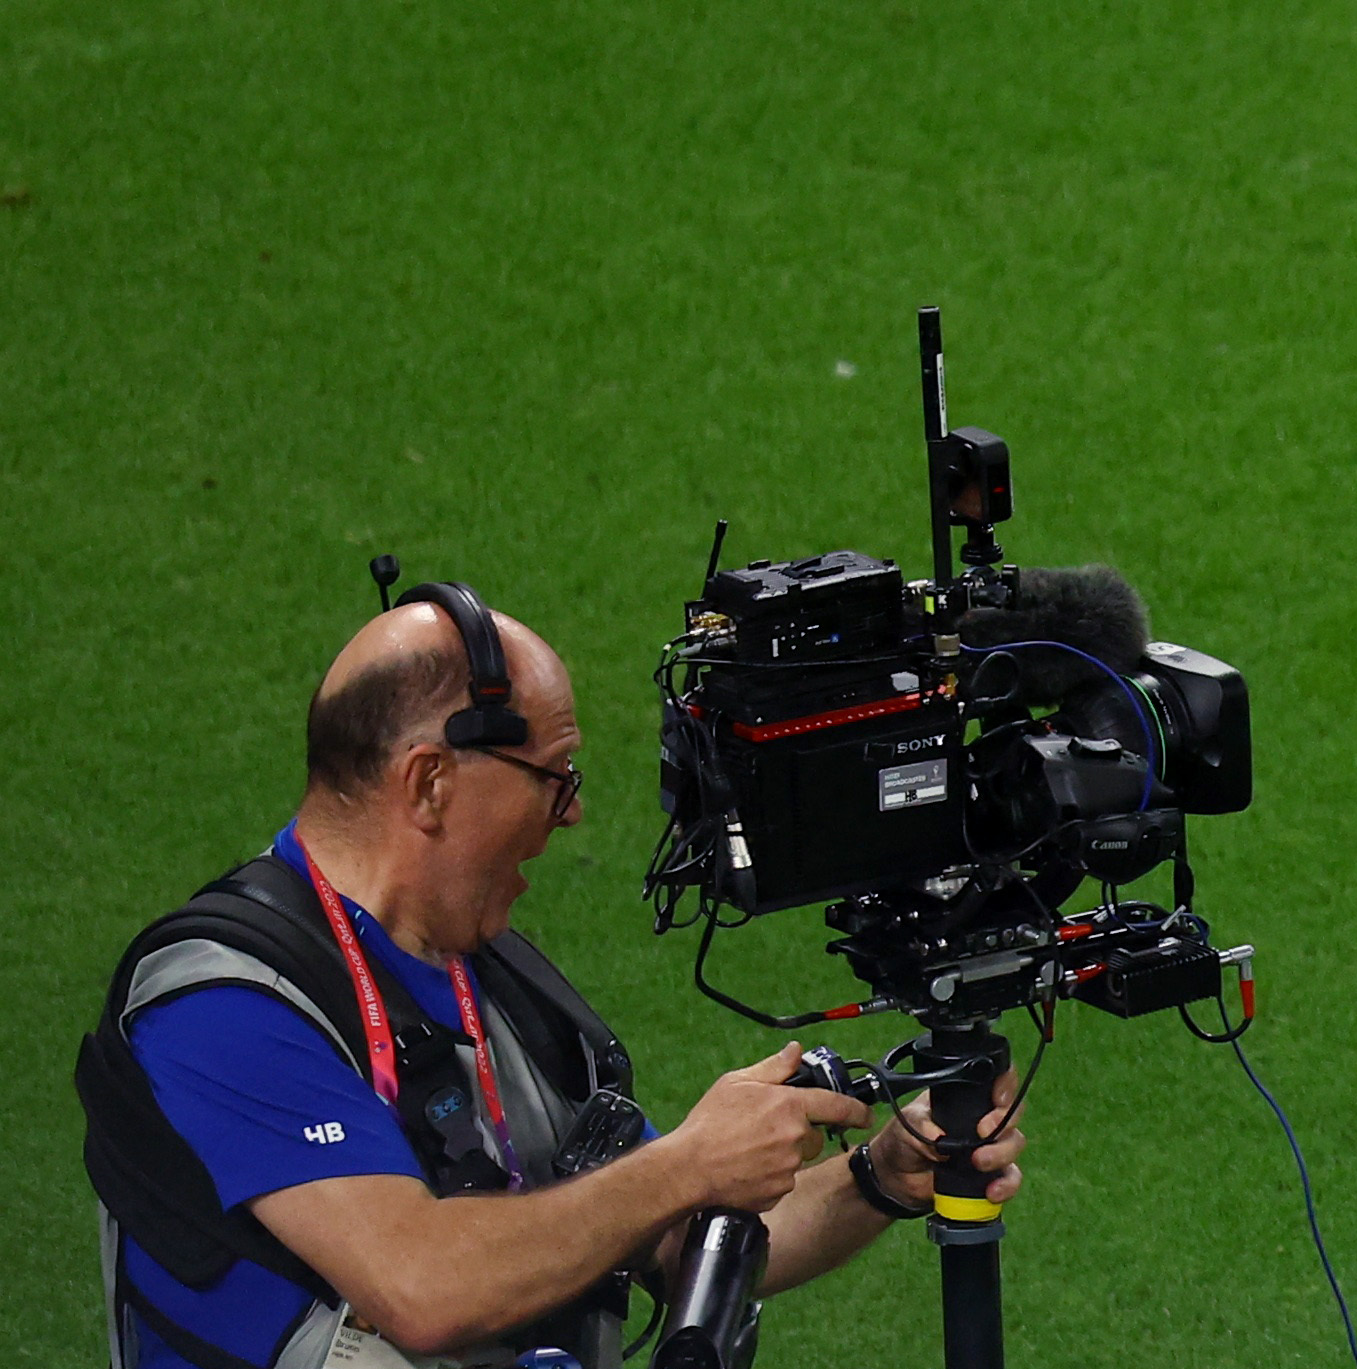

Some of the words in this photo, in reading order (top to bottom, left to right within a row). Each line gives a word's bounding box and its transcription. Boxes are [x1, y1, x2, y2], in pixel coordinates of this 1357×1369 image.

[897, 733, 946, 754] SONY
[1091, 839, 1129, 850] Canon
[347, 948, 362, 966] CUP
[356, 966, 376, 1002] WORLD
[367, 1003, 381, 1027] FIFA
[303, 1121, 346, 1144] HB
